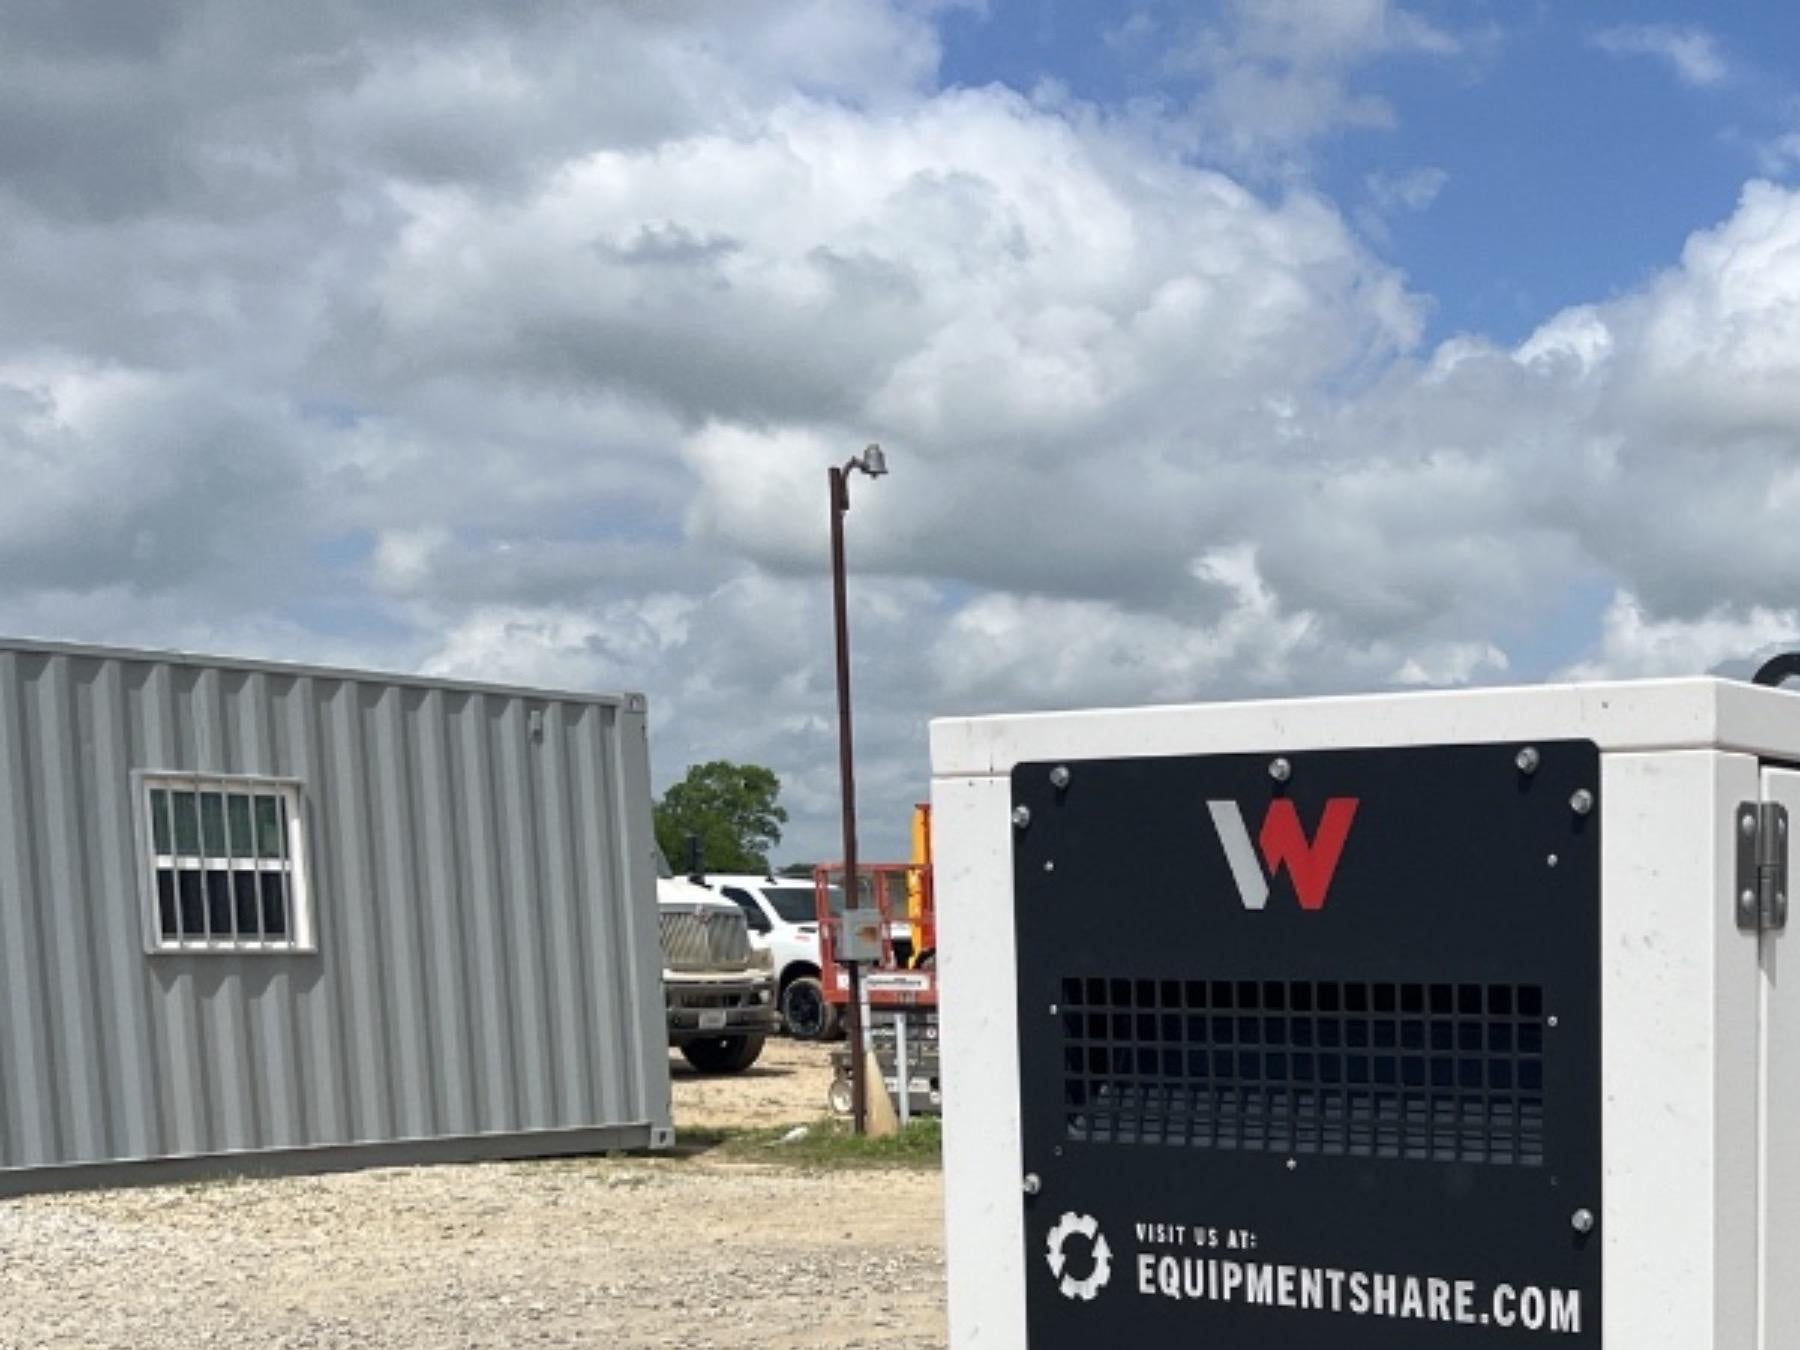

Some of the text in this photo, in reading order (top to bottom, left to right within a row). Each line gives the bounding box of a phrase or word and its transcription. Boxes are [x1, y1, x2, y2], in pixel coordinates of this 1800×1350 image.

[1135, 1222, 1258, 1250] VISIT US AT:
[1136, 1252, 1581, 1334] EQUIPMENTSHARE.COM
